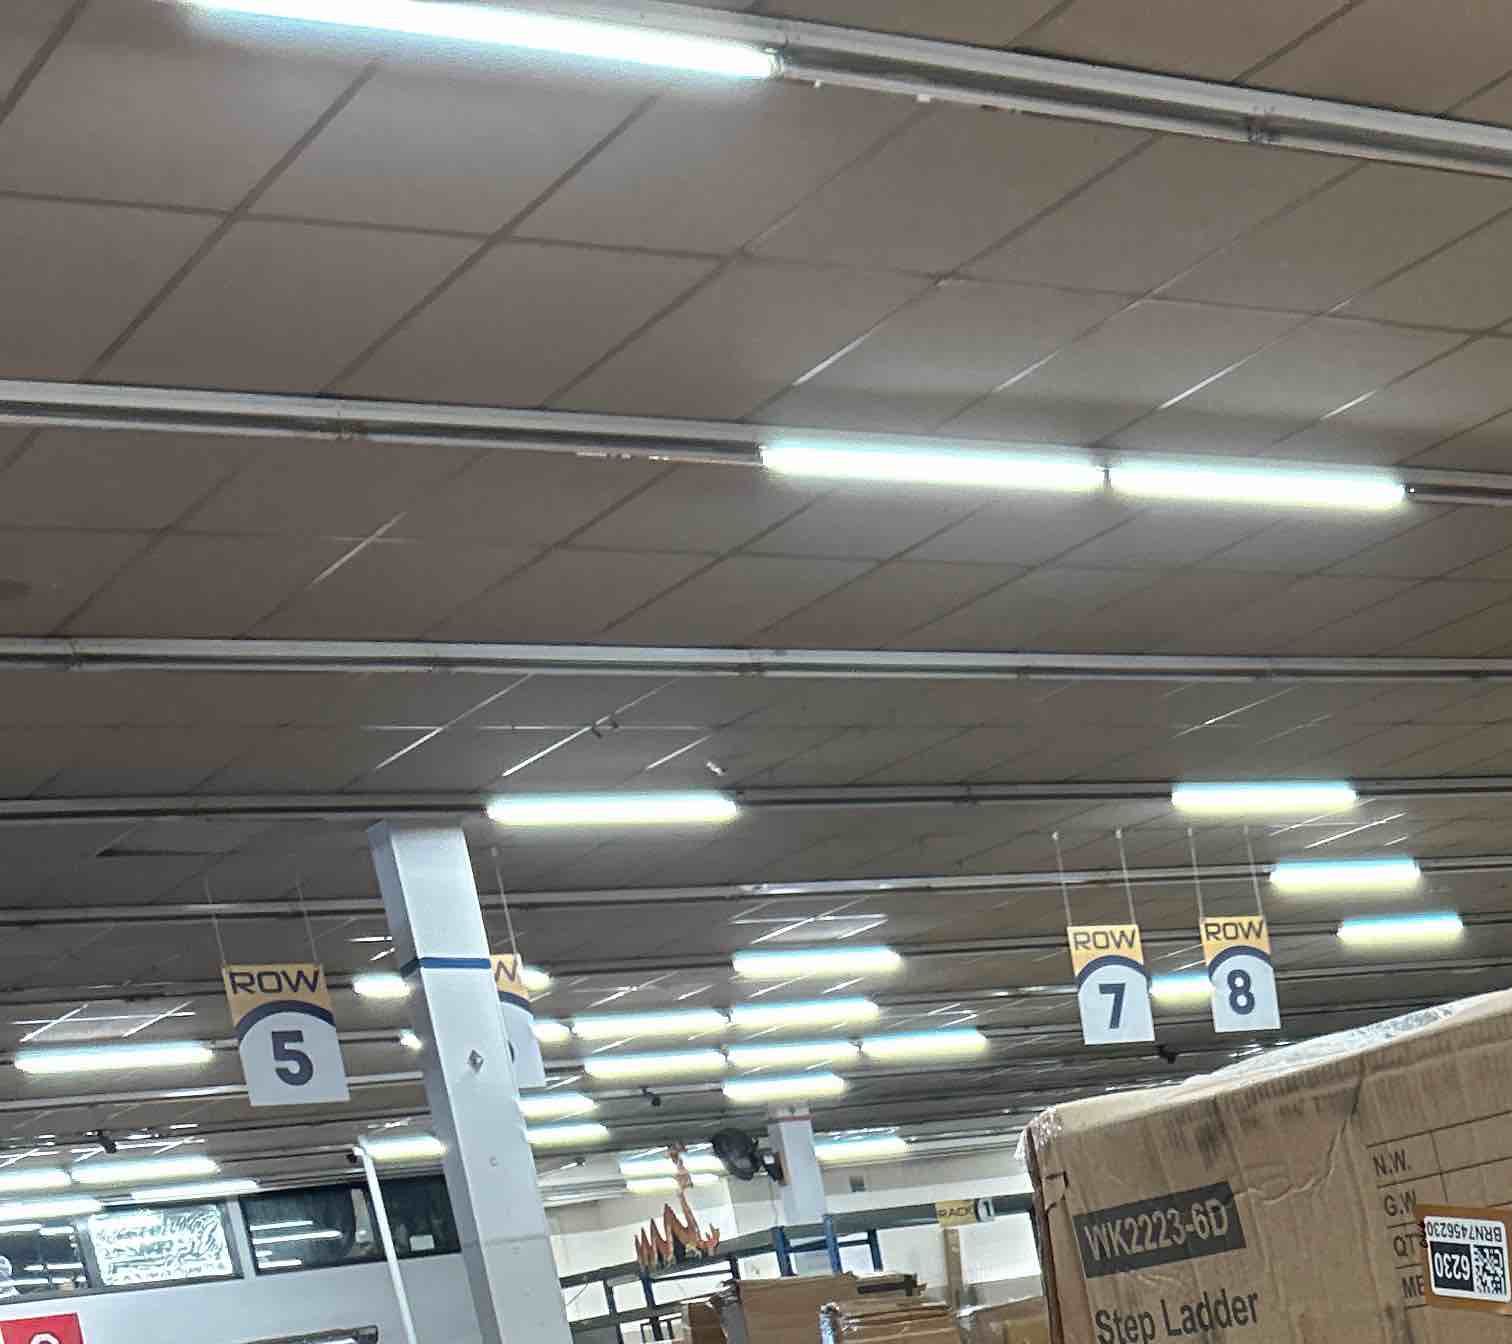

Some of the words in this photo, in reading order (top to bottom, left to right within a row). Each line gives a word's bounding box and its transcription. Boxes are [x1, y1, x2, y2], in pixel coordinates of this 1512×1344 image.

[1073, 928, 1137, 951] ROW
[1203, 919, 1264, 942] ROW
[229, 968, 320, 996] ROW
[1226, 968, 1256, 1016] 8
[1098, 982, 1126, 1030] 7
[271, 1029, 314, 1087] 5
[1372, 1149, 1412, 1177] N.W.
[1083, 1196, 1229, 1262] WK2223-6D
[1426, 1220, 1503, 1243] BRN7456230
[1434, 1251, 1472, 1281] 6230
[1401, 1275, 1425, 1300] ME
[1159, 1287, 1260, 1337] Ladder
